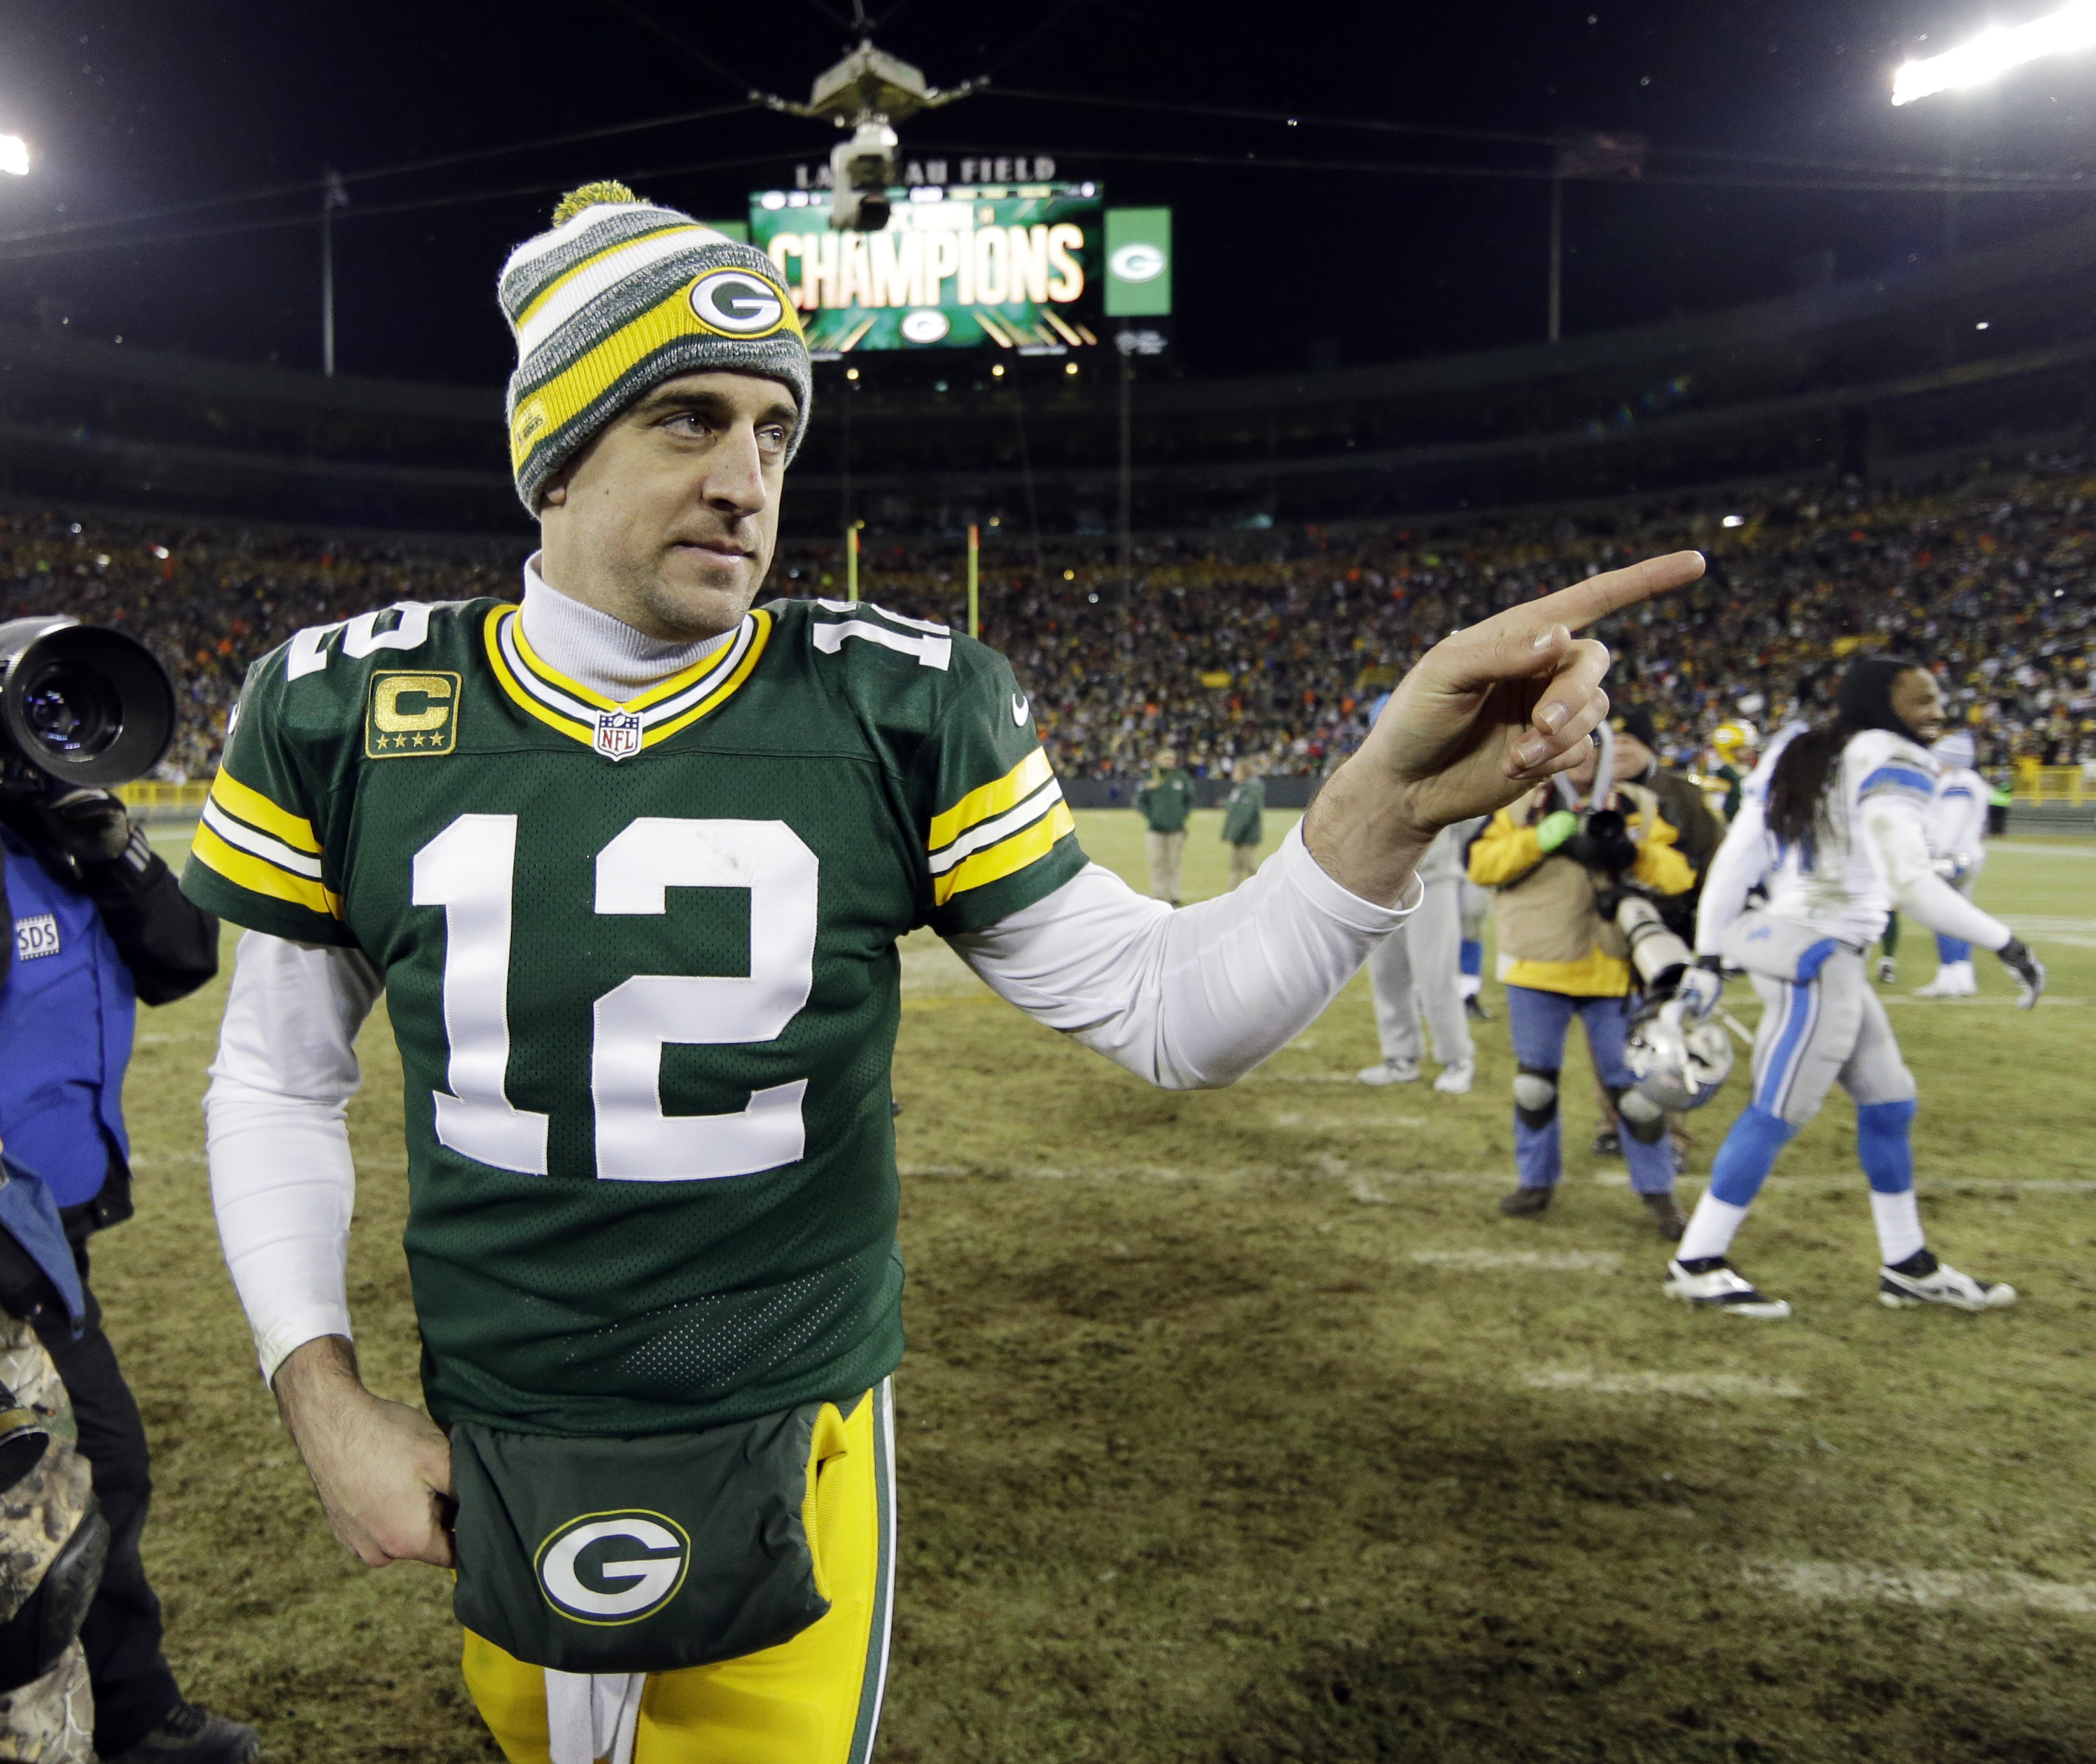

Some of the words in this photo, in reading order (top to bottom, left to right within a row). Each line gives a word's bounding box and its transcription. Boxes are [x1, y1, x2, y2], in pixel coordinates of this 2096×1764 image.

[795, 160, 948, 190] LAAU
[960, 155, 1056, 183] FIELD
[768, 223, 1084, 310] CHAMPIONS
[690, 271, 783, 332] G
[374, 676, 452, 733] C
[601, 729, 634, 752] NFL
[18, 923, 56, 951] SDS
[412, 813, 820, 1182] 12
[543, 1518, 682, 1615] G
